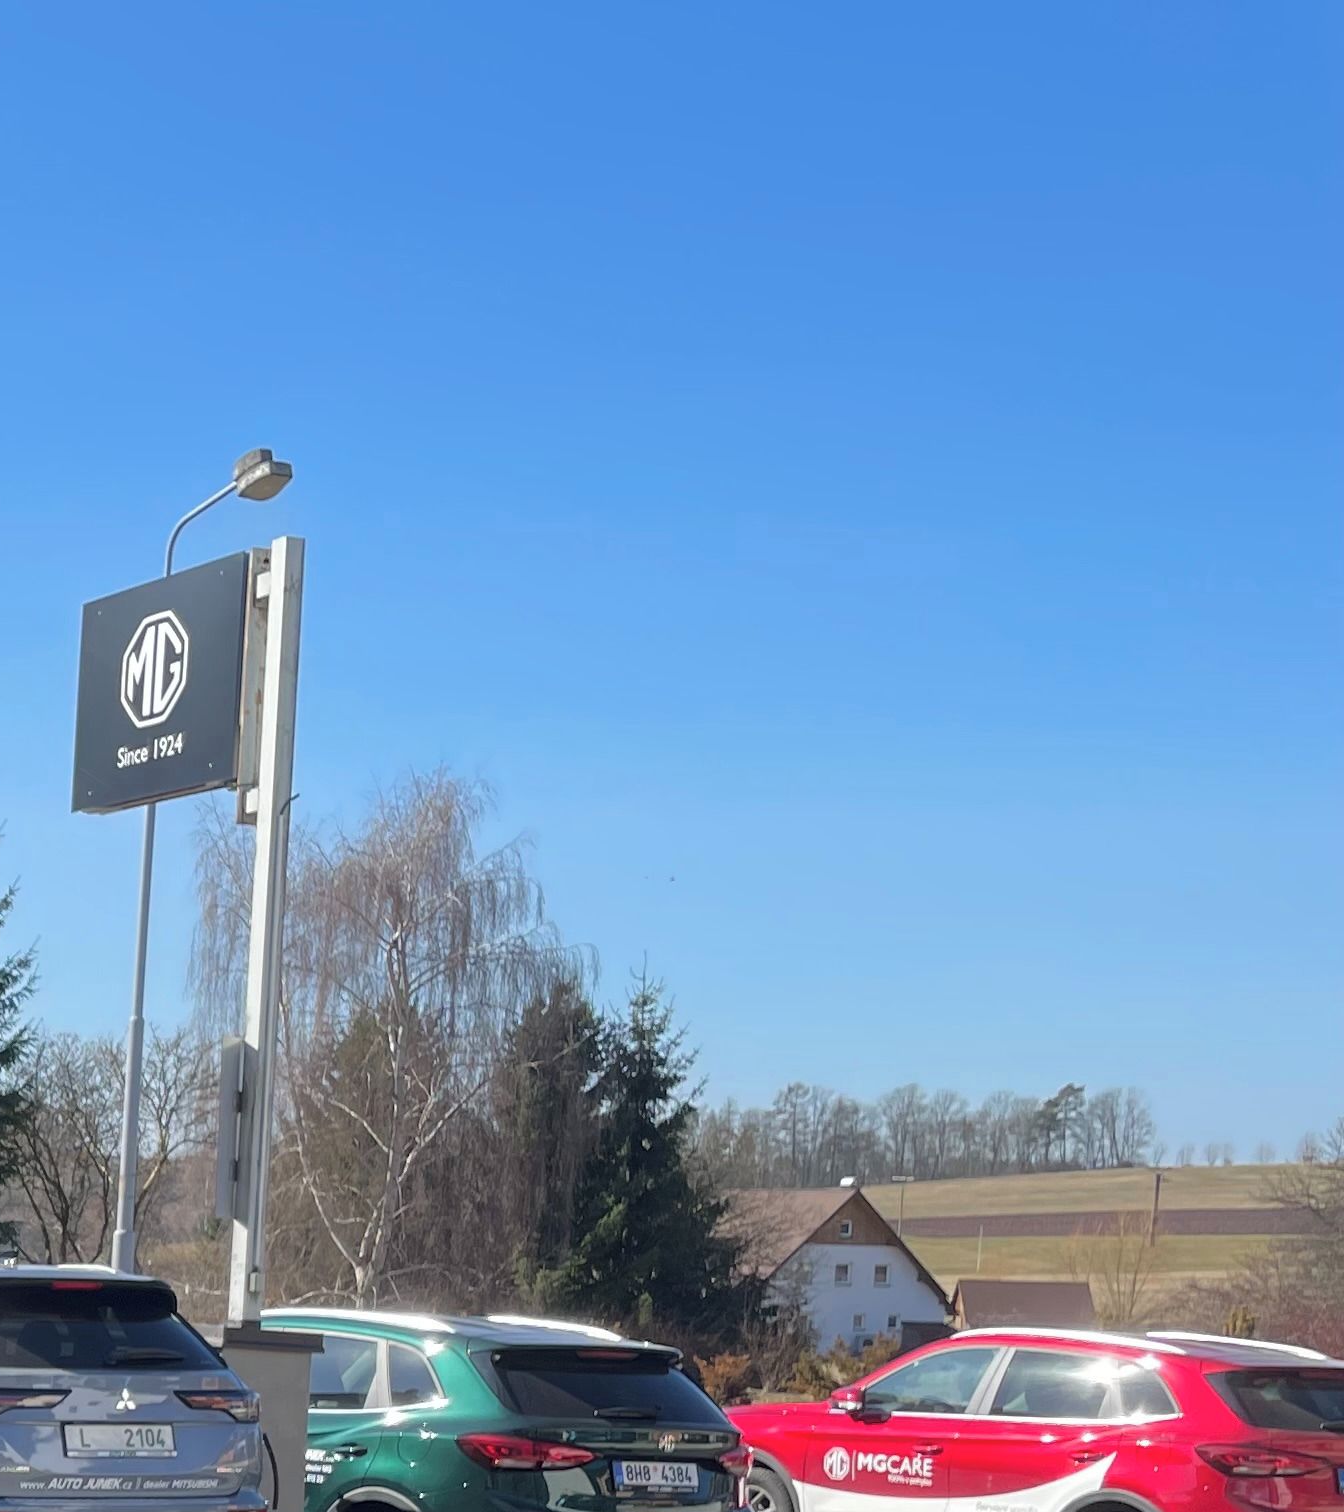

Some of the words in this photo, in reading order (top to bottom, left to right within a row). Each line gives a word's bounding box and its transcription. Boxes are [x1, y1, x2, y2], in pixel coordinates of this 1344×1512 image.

[127, 621, 183, 717] MG
[117, 746, 148, 768] Since
[153, 733, 183, 760] 1924
[79, 1428, 91, 1448] L
[124, 1428, 166, 1448] 2104
[625, 1464, 651, 1481] 8H8
[662, 1465, 692, 1483] 4384
[825, 1449, 849, 1479] MG
